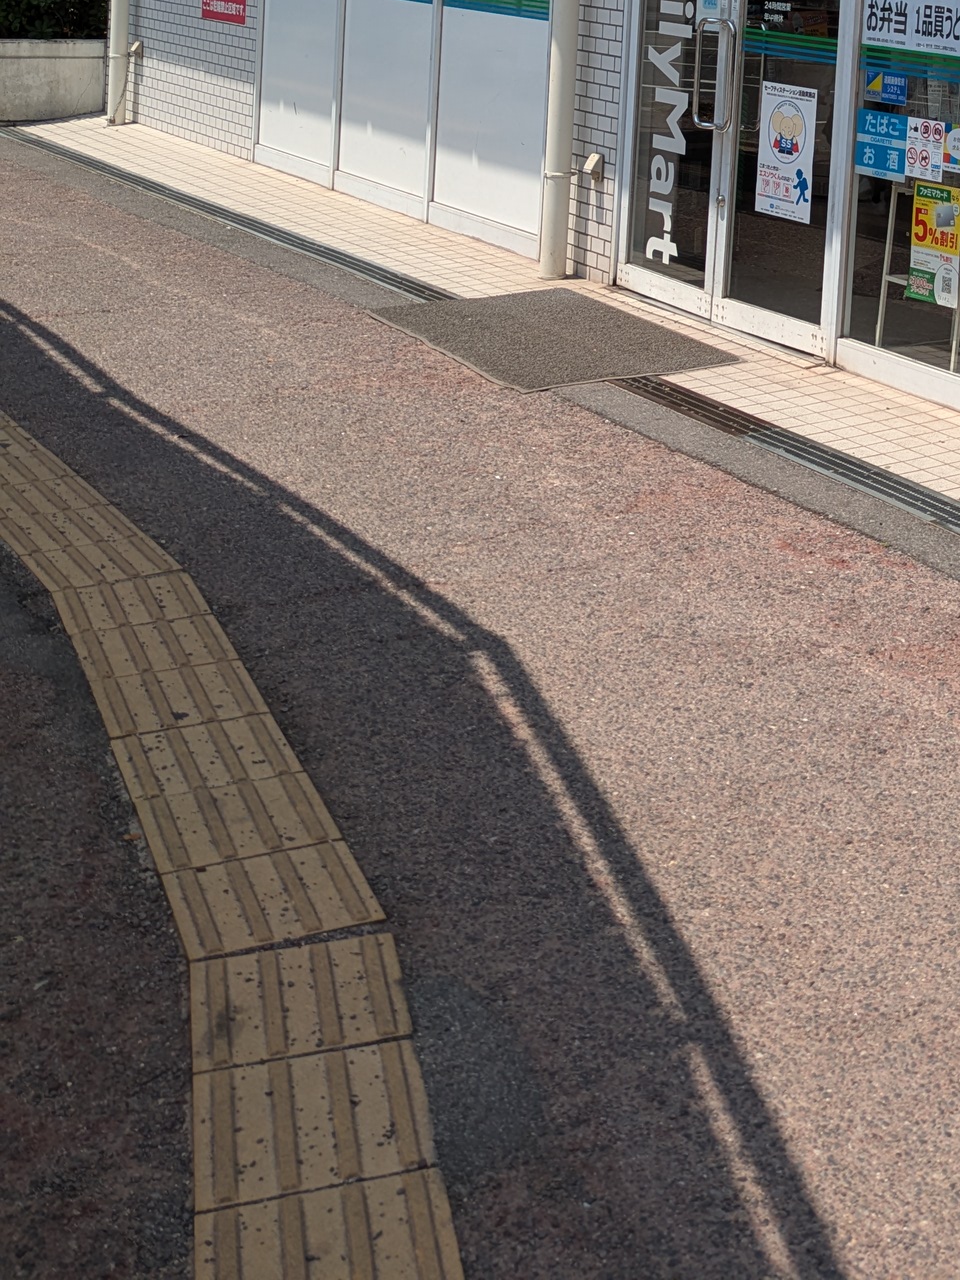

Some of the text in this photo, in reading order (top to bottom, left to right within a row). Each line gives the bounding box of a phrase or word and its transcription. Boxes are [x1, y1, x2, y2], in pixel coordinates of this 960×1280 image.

[764, 1, 792, 12] 24時間営業
[763, 12, 784, 23] 年中無休
[886, 85, 901, 94] システム
[865, 113, 901, 134] たばこ
[781, 139, 792, 148] SS
[870, 136, 893, 146] CIGARETTE
[863, 146, 899, 170] お酒
[872, 170, 888, 178] LIQUOR
[920, 187, 948, 200] ファミマカード
